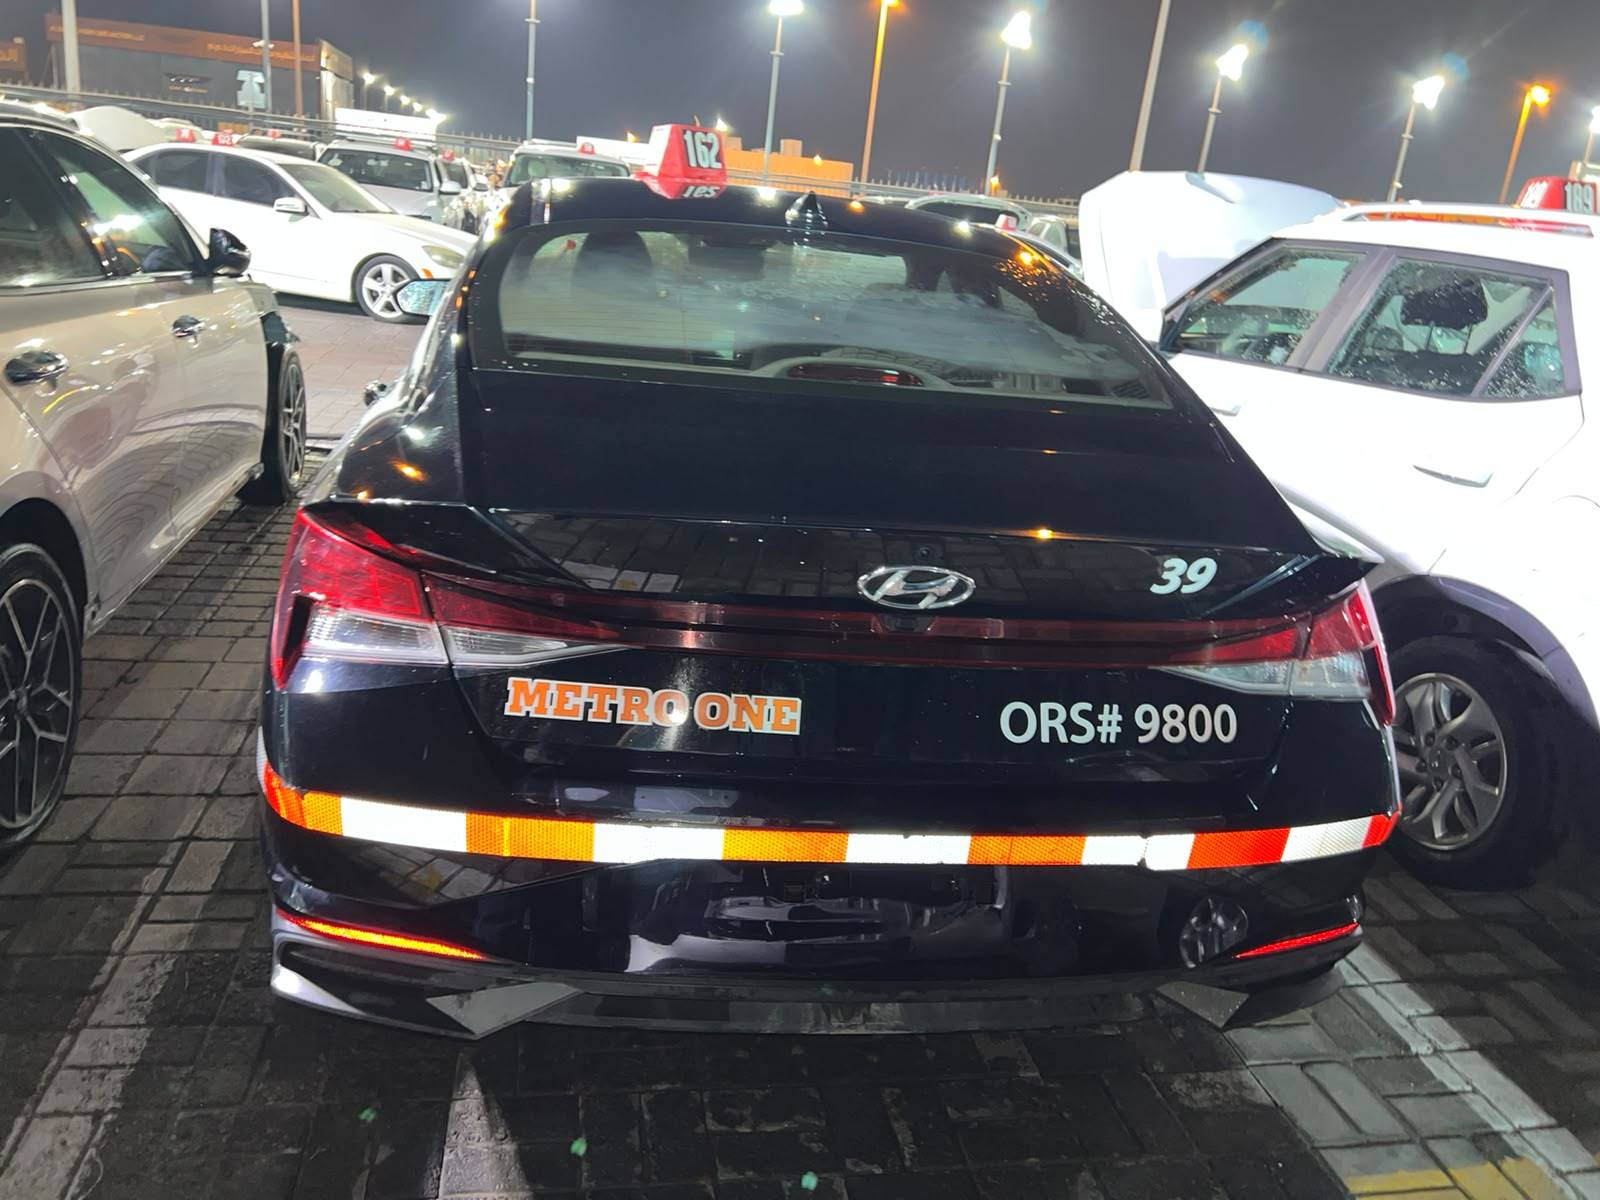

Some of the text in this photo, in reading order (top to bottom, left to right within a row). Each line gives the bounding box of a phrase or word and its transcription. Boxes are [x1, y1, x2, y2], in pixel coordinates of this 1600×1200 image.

[683, 130, 722, 169] 162
[1565, 182, 1593, 214] 189
[1150, 557, 1218, 595] 39
[504, 677, 802, 735] METRO ONE
[1000, 701, 1238, 744] ORS# 9800
